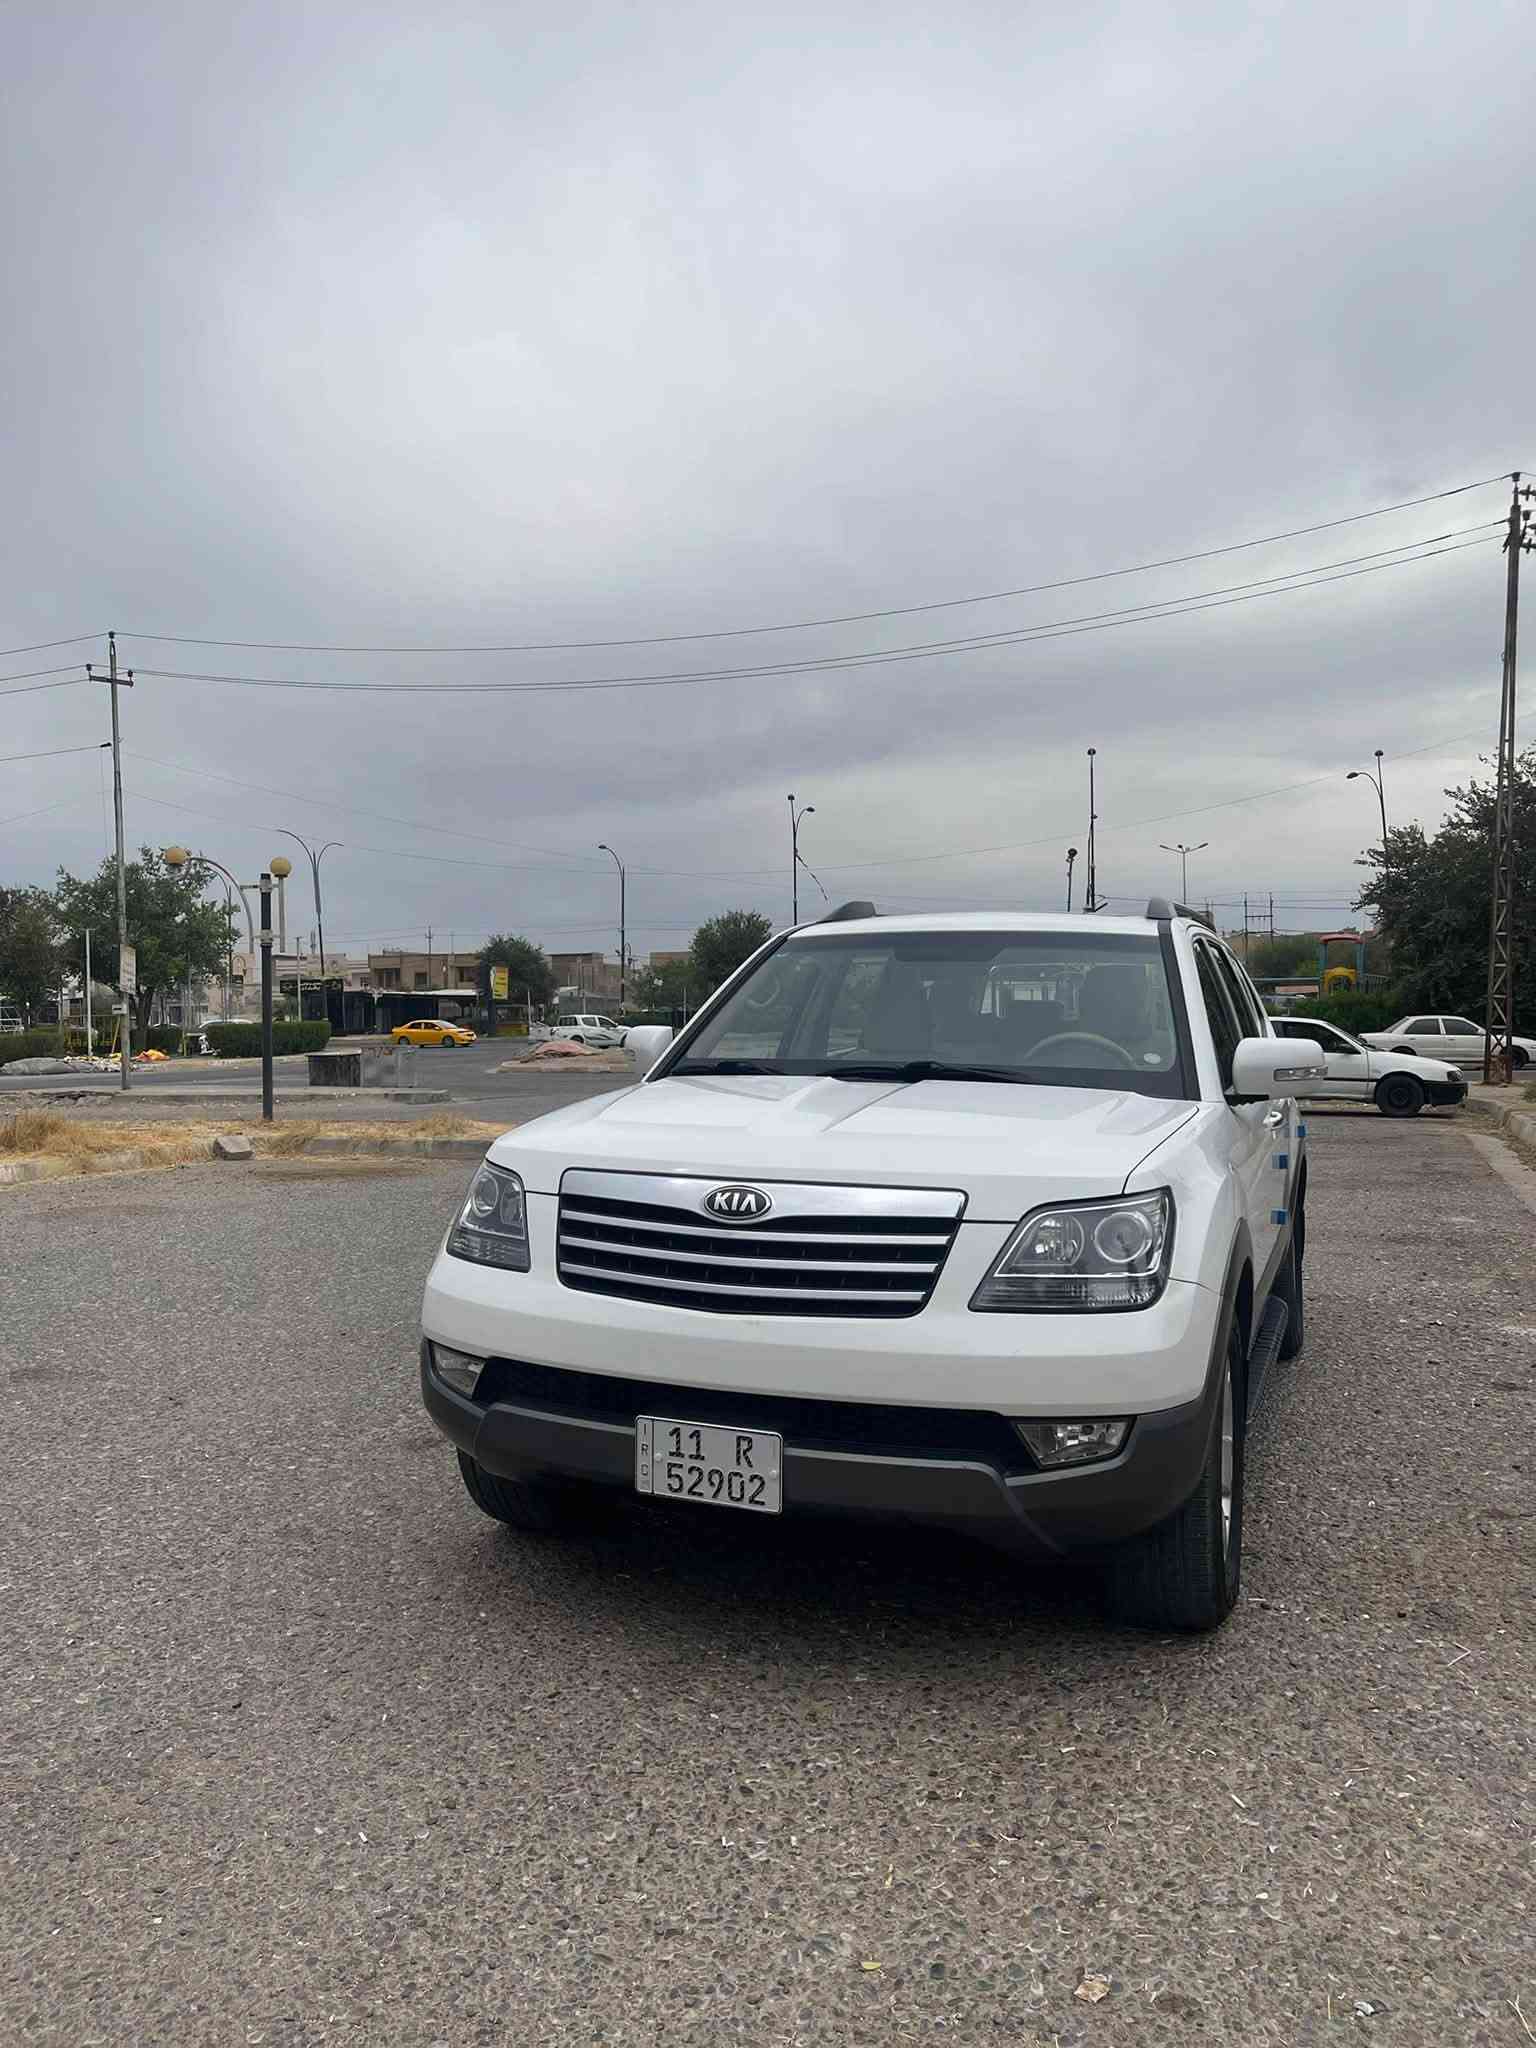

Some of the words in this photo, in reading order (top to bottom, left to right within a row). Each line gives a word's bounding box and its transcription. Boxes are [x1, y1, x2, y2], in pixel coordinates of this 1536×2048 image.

[713, 1191, 757, 1212] KIA
[668, 1427, 705, 1461] 11
[736, 1435, 753, 1468] R
[666, 1462, 766, 1506] 52902
